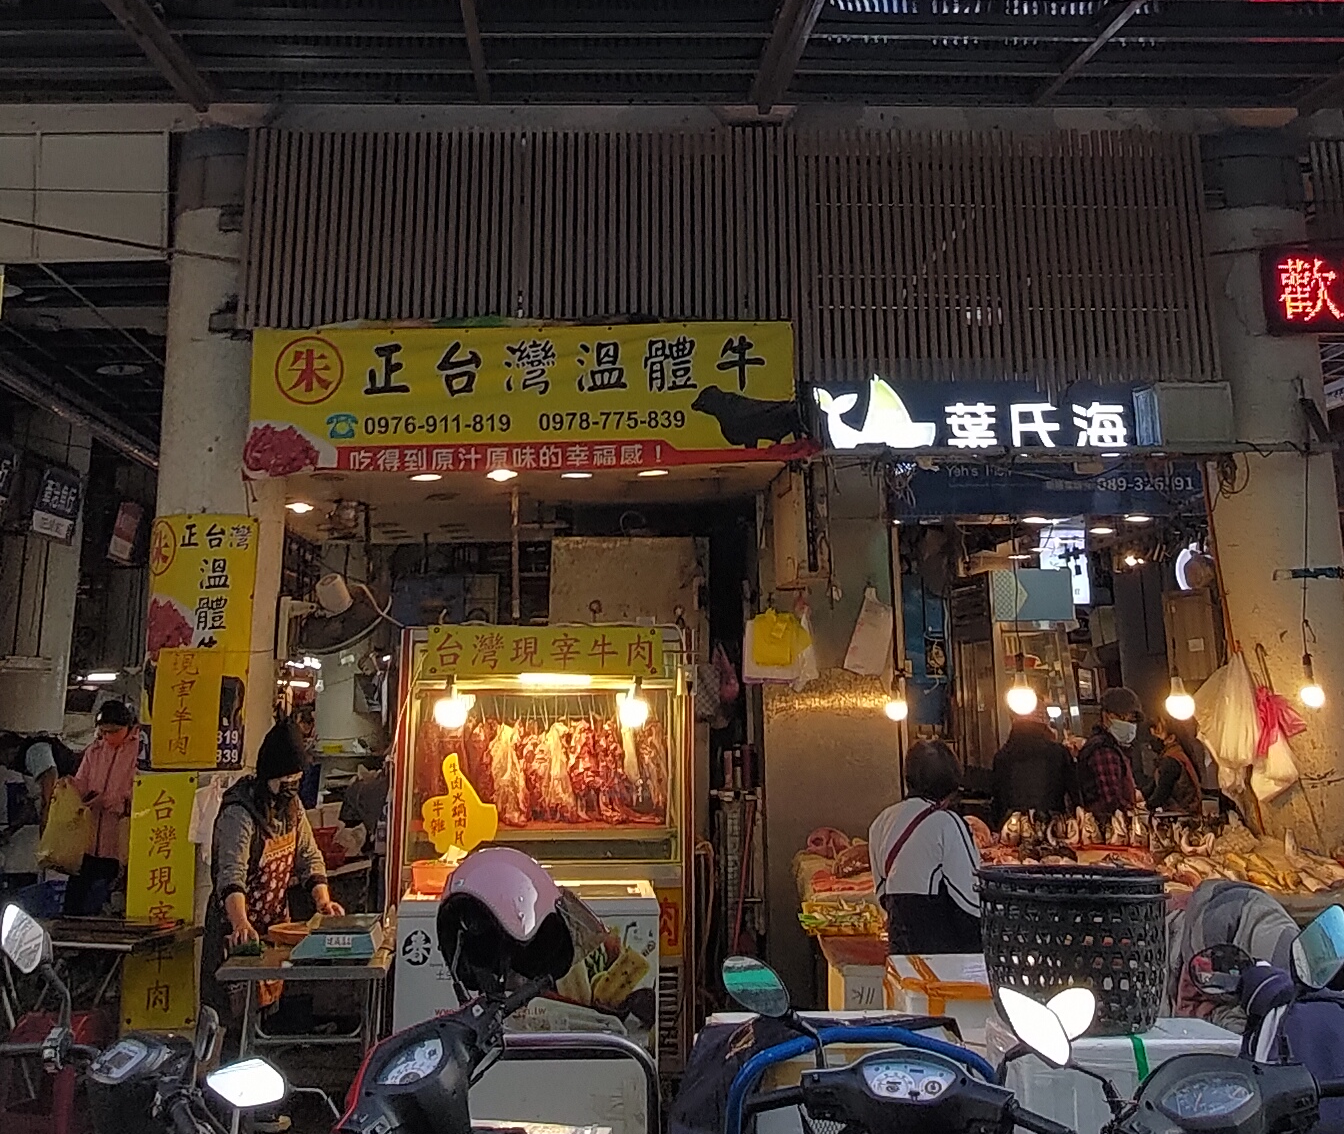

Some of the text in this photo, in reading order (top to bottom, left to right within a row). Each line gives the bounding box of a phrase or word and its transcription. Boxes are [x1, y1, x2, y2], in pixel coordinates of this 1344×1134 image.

[362, 336, 766, 396] 正台灣溫體牛
[363, 410, 686, 436] 0976-911-819 0978-775-839
[944, 403, 1128, 448] 葉氏海
[437, 632, 655, 670] 台灣現宰牛肉
